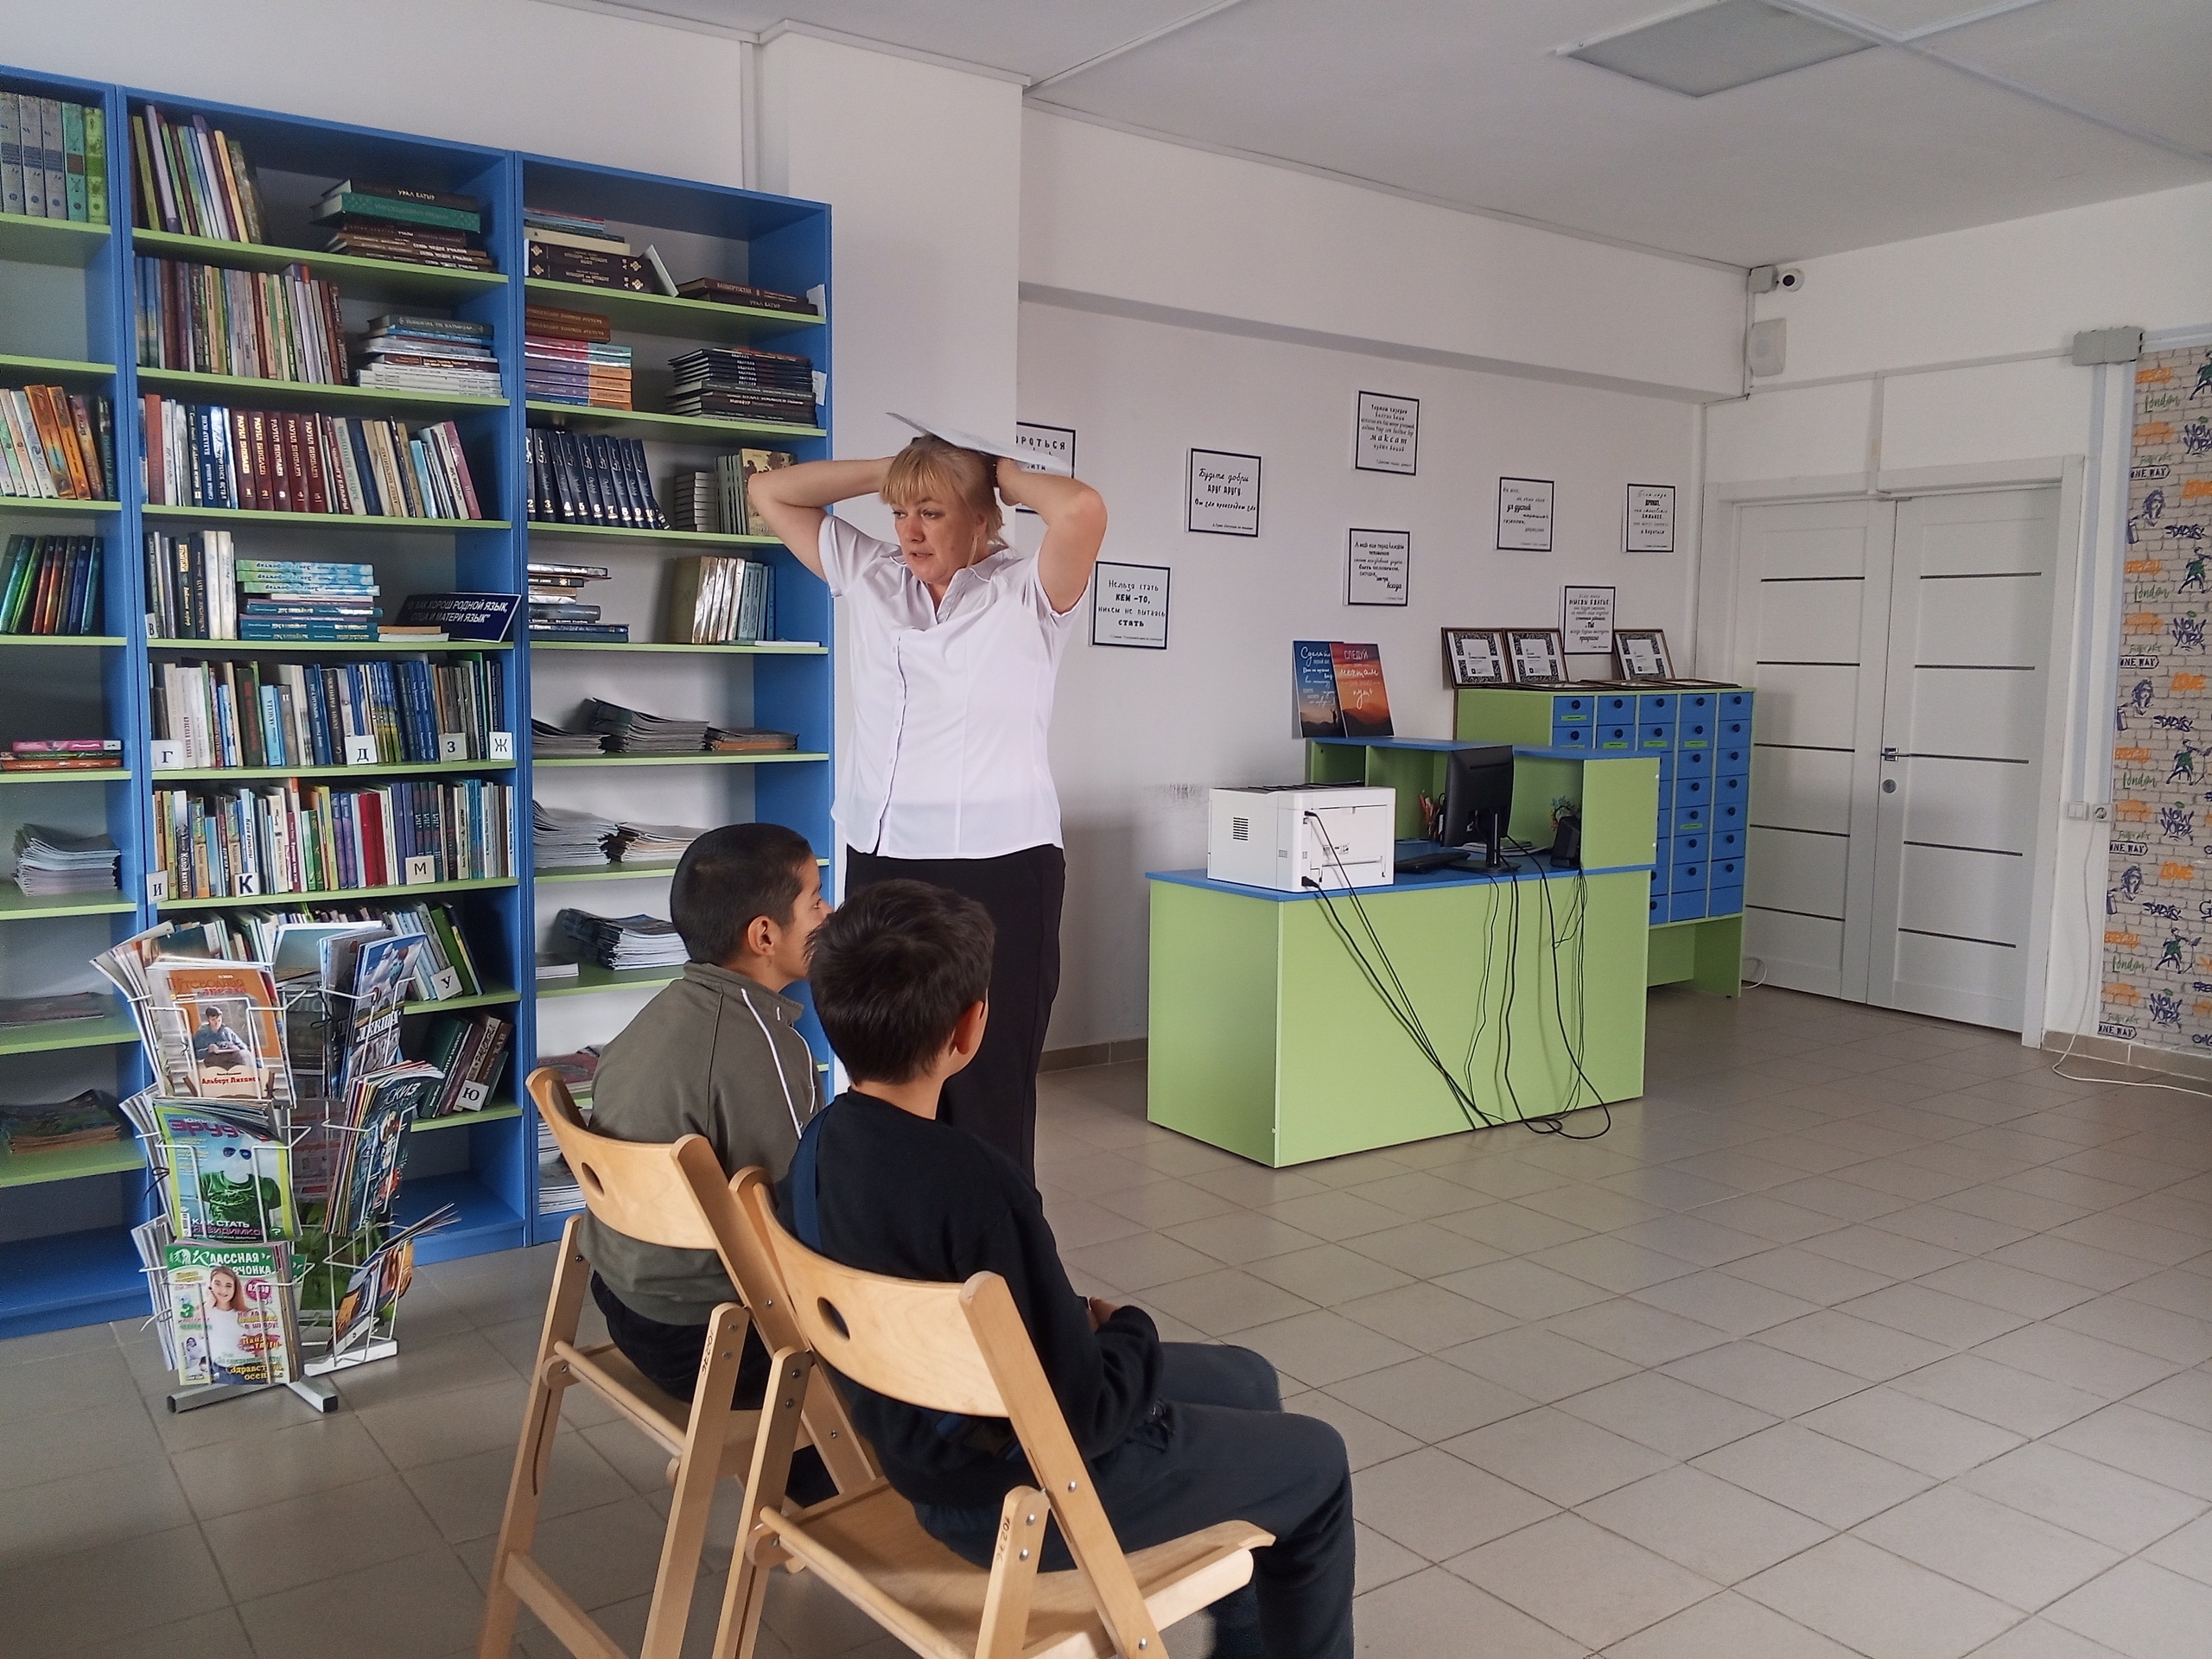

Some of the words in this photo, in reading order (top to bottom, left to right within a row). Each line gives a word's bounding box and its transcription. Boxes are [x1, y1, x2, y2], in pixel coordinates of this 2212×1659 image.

[2145, 393, 2180, 412] London
[2150, 467, 2166, 477] WAY
[544, 499, 551, 508] 3
[563, 501, 572, 511] 4
[578, 502, 585, 511] 5
[594, 504, 601, 512] 6
[607, 505, 615, 514] 7
[621, 507, 629, 516] 8
[634, 507, 641, 516] 9
[2134, 585, 2169, 602] London
[453, 599, 485, 611] РОДНОЙ
[483, 601, 508, 613] ЯЗЫК,
[149, 623, 155, 635] В
[2139, 657, 2156, 667] WAY
[494, 738, 507, 752] Ж
[162, 751, 174, 764] Г
[357, 747, 369, 762] Д
[2122, 770, 2158, 789] London
[2127, 843, 2144, 854] WAY
[414, 862, 427, 875] М
[153, 883, 162, 896] И
[238, 874, 253, 894] К
[2112, 957, 2146, 973] London
[440, 976, 452, 988] У
[2116, 1026, 2133, 1038] WAY
[461, 1087, 480, 1102] Ю
